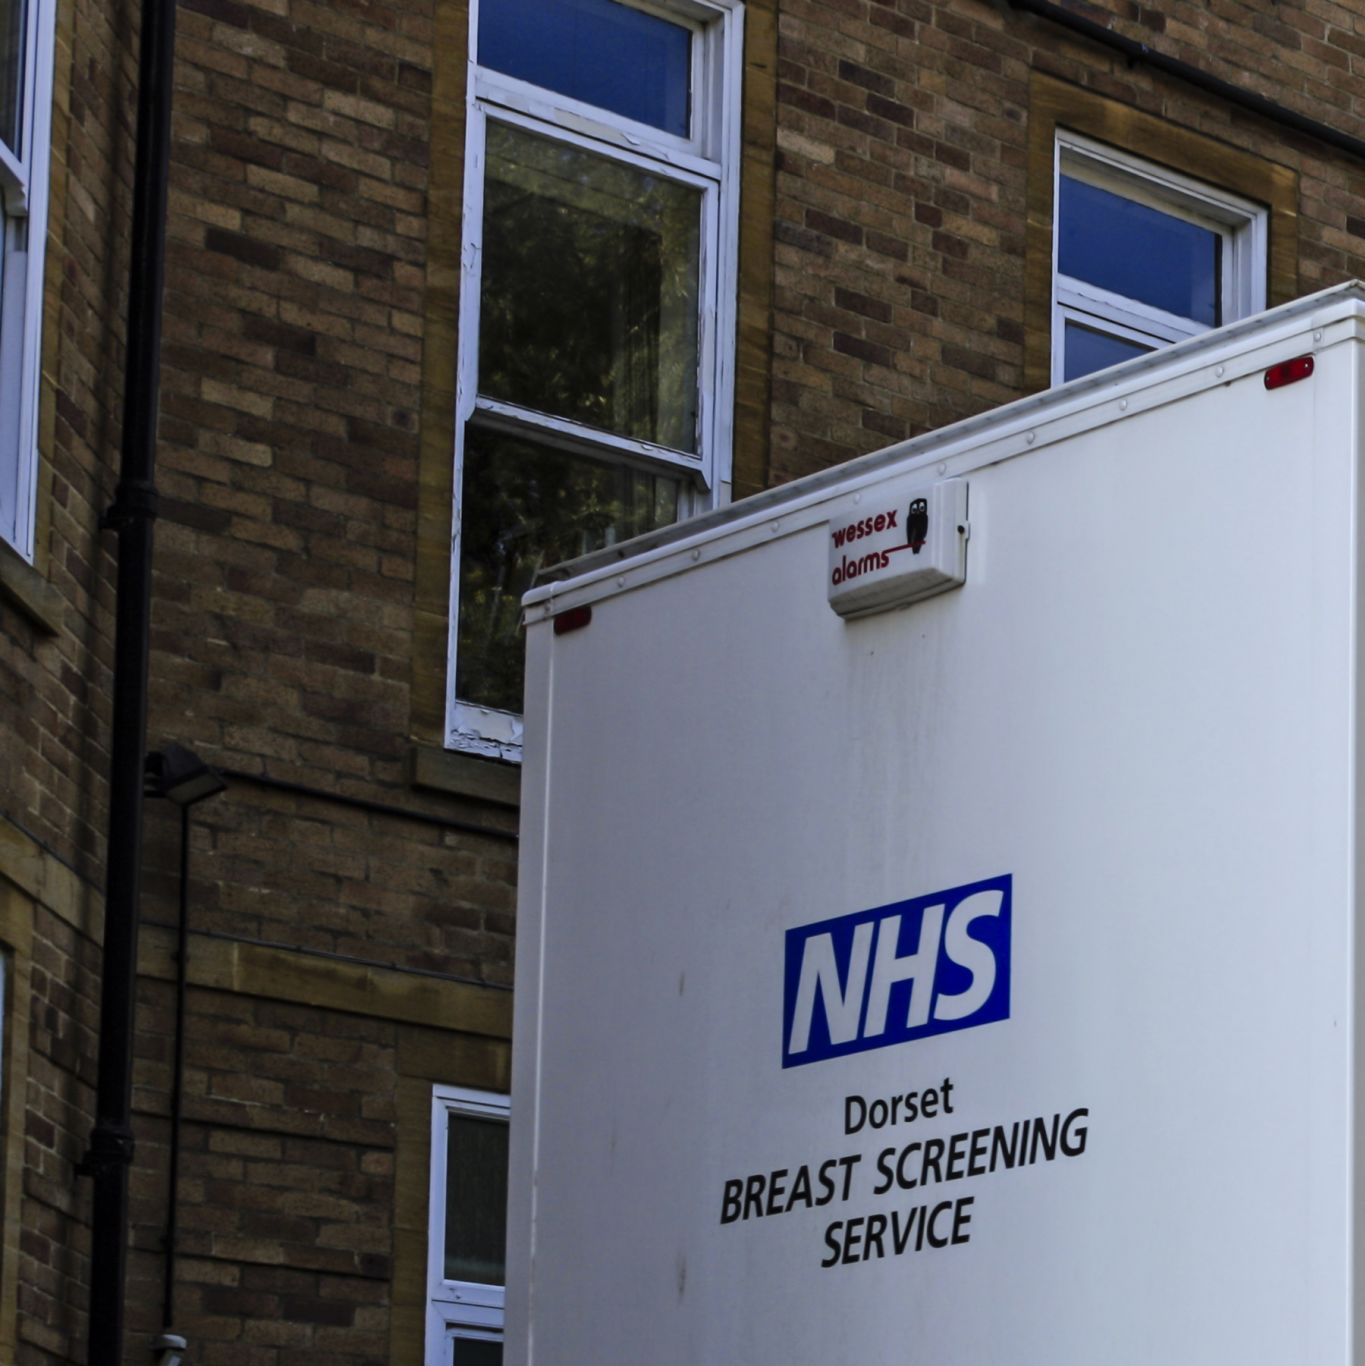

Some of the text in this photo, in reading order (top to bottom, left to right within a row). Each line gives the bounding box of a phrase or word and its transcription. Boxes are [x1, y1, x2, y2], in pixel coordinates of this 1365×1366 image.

[832, 510, 897, 548] wessex
[832, 551, 890, 585] alarms
[788, 890, 1004, 1055] NHS
[844, 1077, 954, 1135] Dorset
[720, 1107, 1089, 1224] BREAST SCREENING
[821, 1196, 975, 1268] SERVICE
